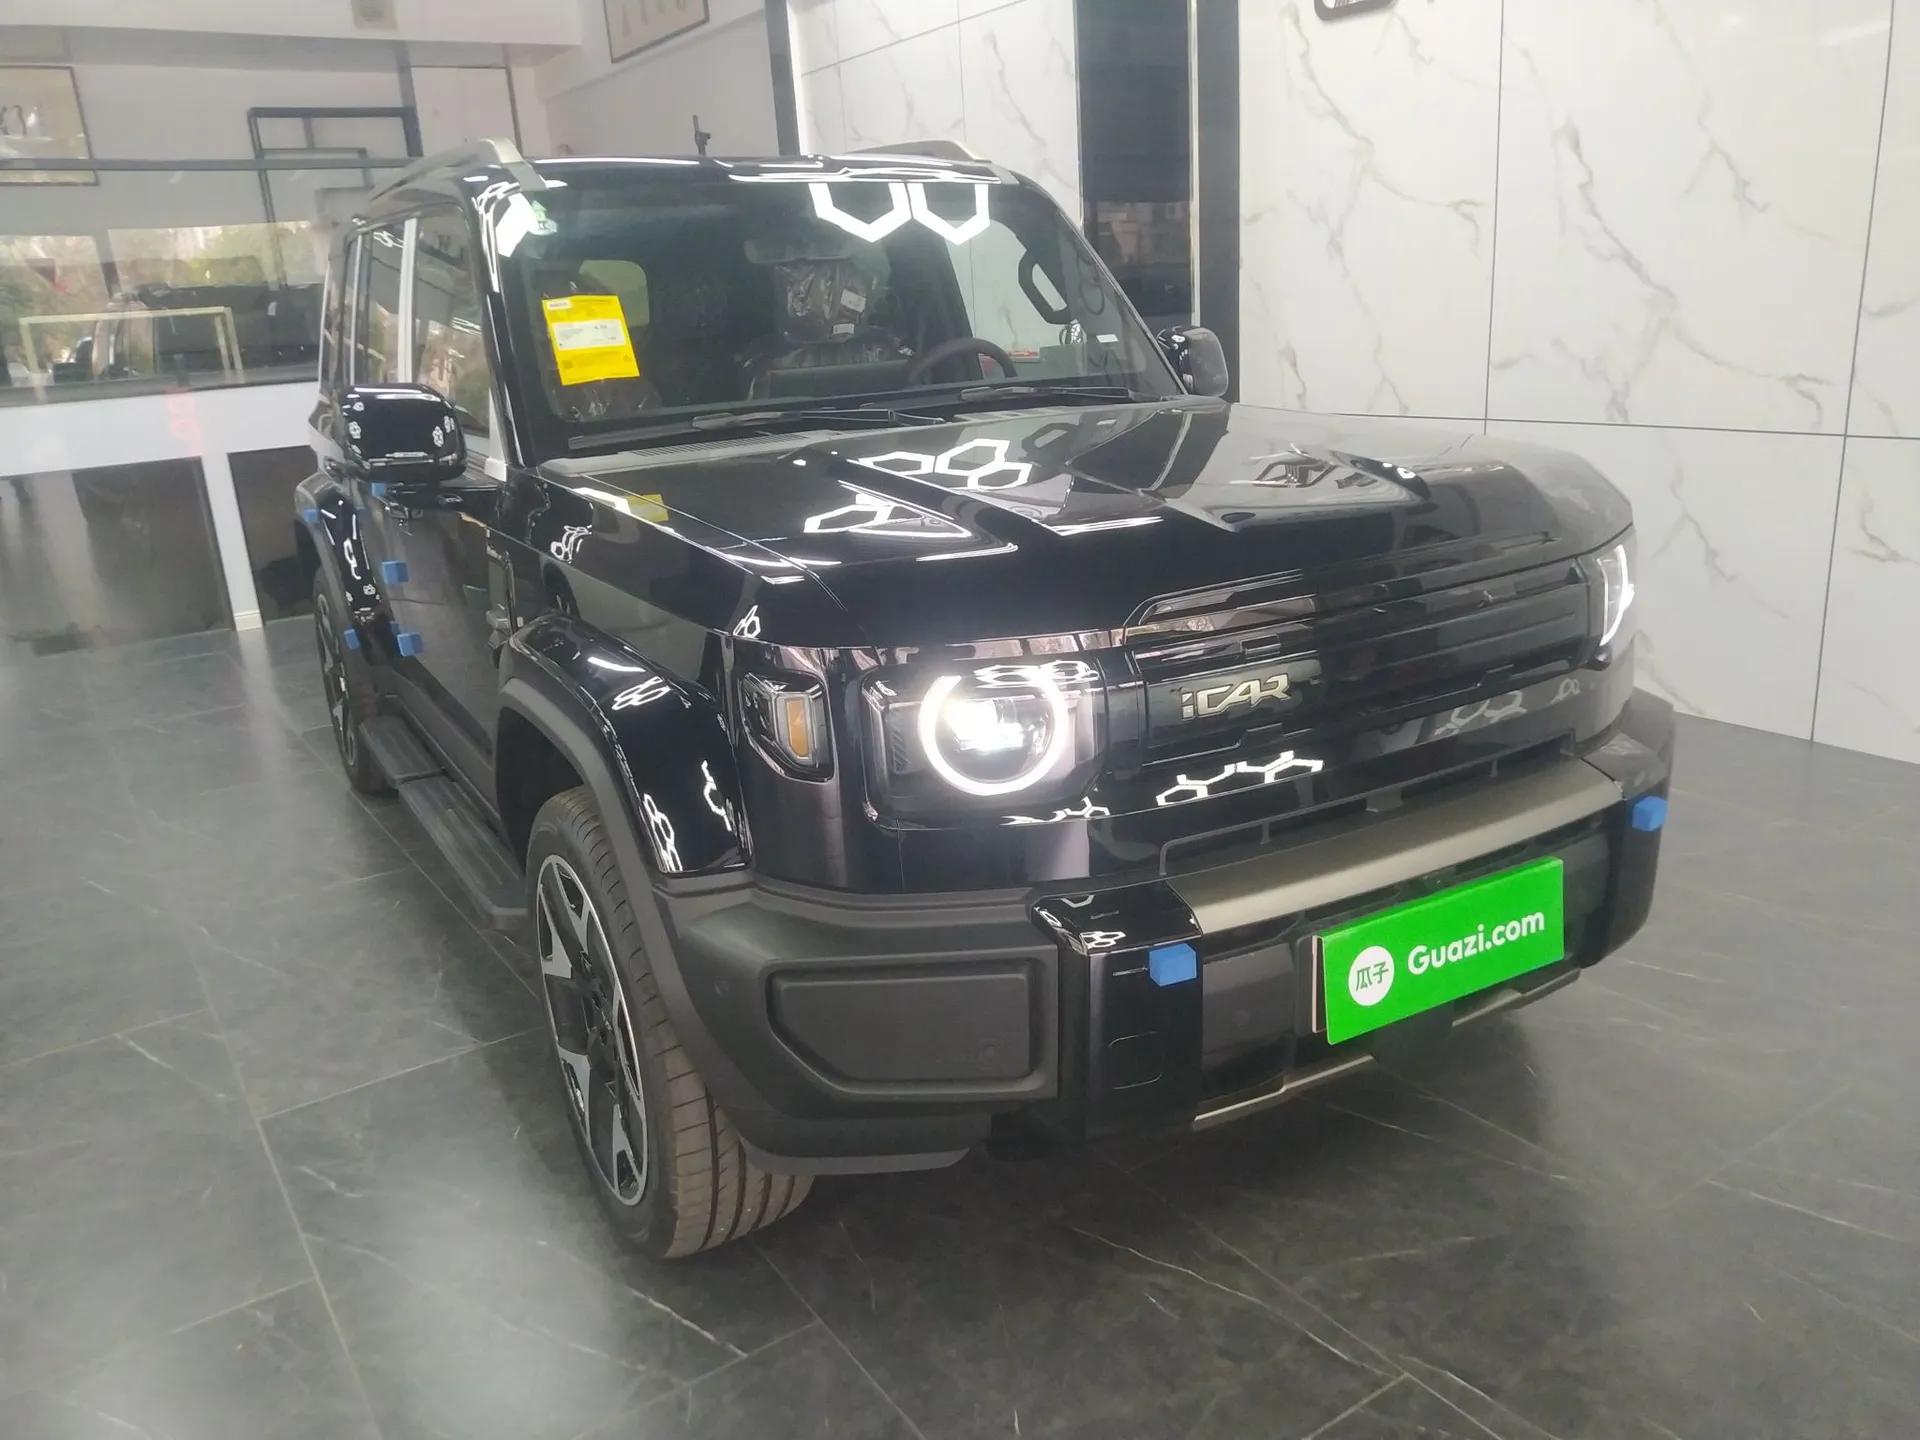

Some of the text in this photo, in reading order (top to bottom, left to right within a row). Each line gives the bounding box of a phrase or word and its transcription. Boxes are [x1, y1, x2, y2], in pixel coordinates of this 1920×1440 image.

[1181, 673, 1292, 720] iCAR
[1407, 911, 1545, 976] Guazi.com
[1355, 961, 1390, 992] 瓜子
